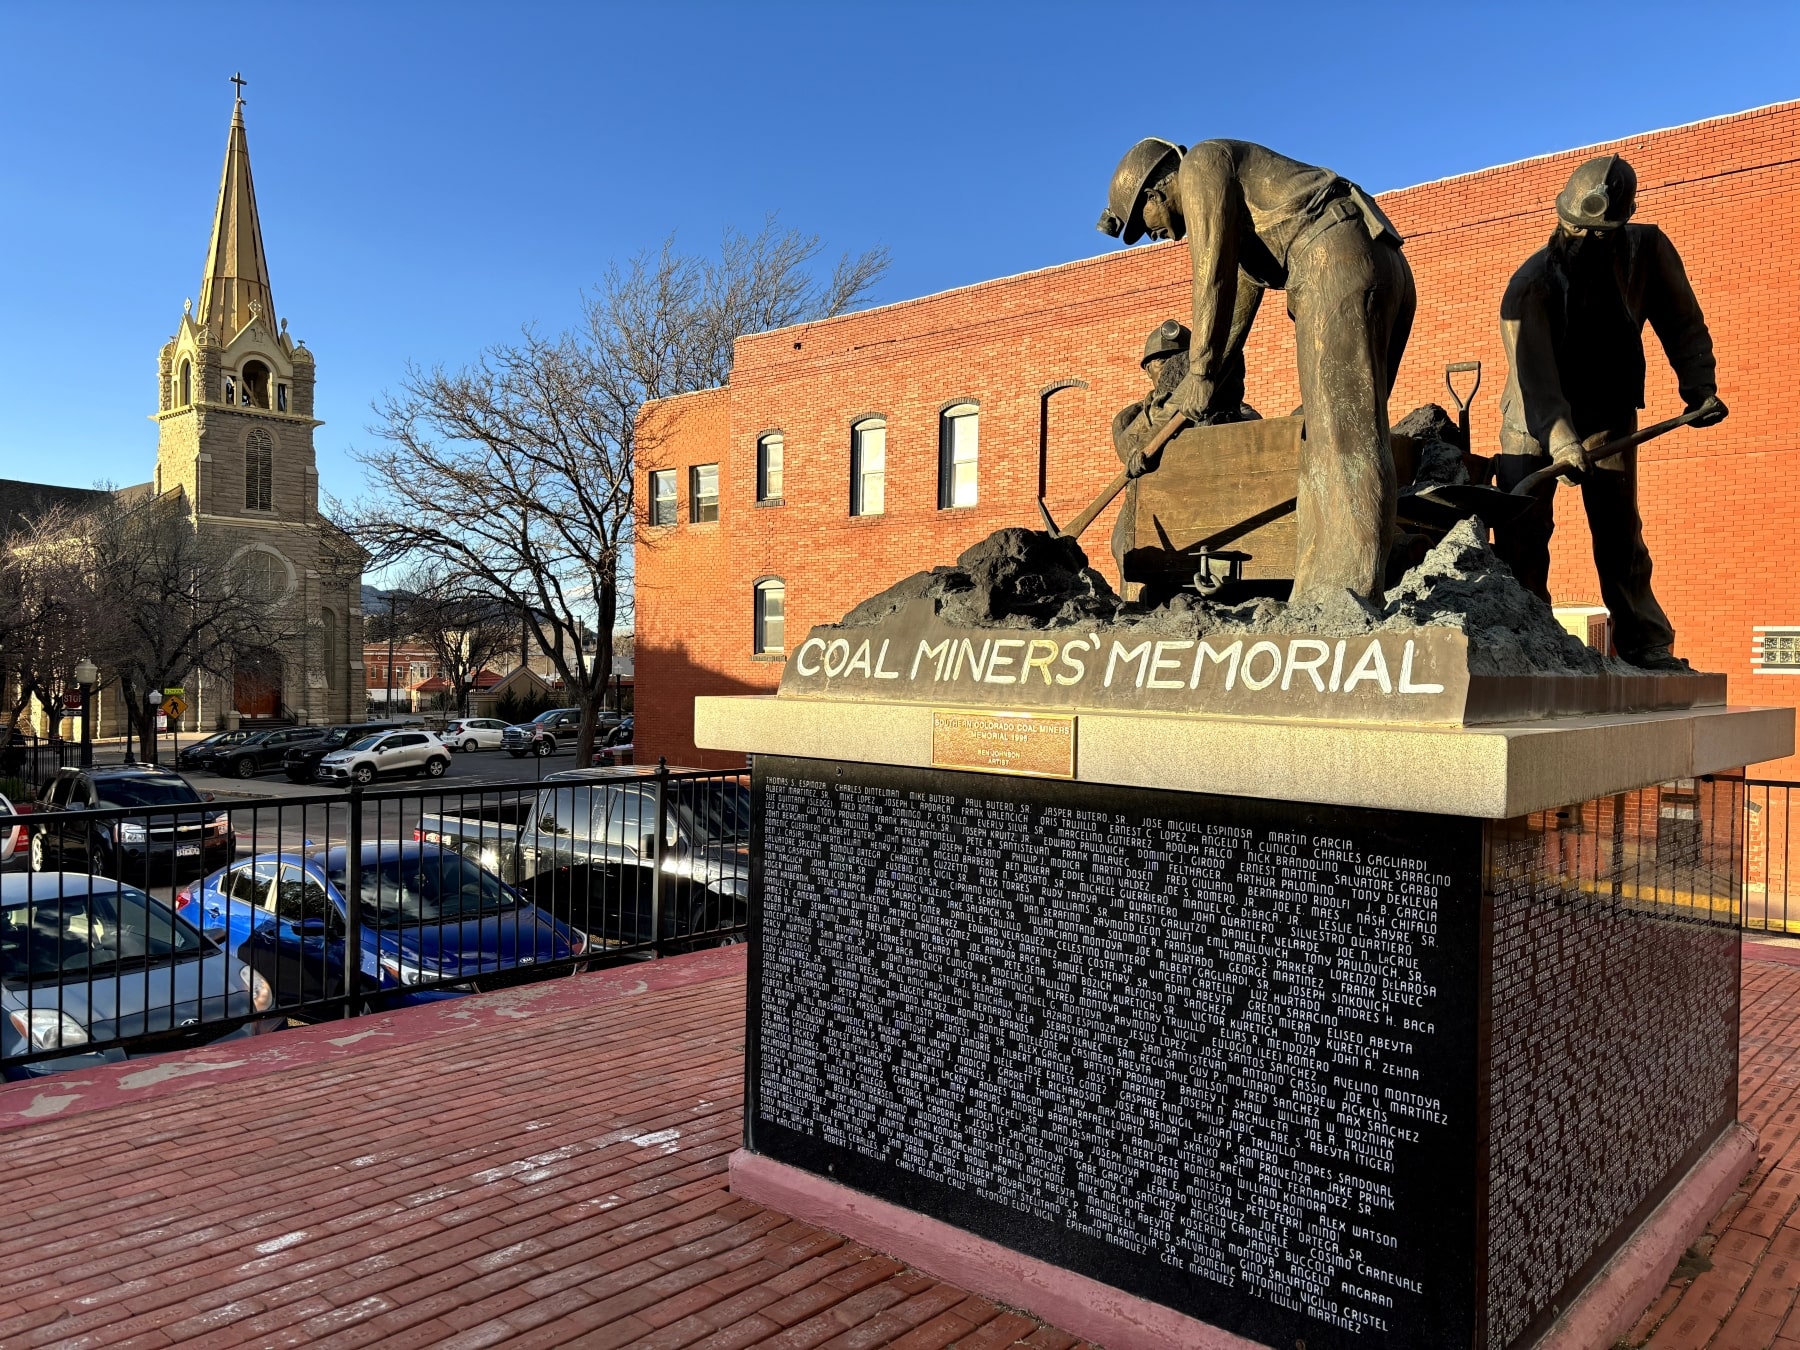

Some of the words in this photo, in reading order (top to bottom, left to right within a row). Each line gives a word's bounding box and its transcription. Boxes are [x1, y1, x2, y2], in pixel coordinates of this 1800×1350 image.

[796, 638, 900, 680] COAL
[1103, 639, 1444, 695] MEMORIAL
[935, 718, 972, 729] SOUTHERN
[974, 722, 1014, 732] COLORADO
[1017, 723, 1037, 733] COAL
[971, 731, 1008, 742] MEMORIAL
[988, 758, 1009, 766] ARTIST
[991, 751, 1021, 760] JOHNSON
[1141, 817, 1162, 829] JOSE
[1167, 820, 1202, 833] MIGUEL
[1207, 824, 1253, 839] ESPINOSA
[1268, 831, 1307, 845] MARTIN
[1312, 836, 1353, 851] GARCIA
[1005, 861, 1020, 871] BEN
[1023, 863, 1050, 876] RIVERA
[1247, 851, 1270, 864] NICK
[1275, 855, 1338, 873] BRANDOLINO
[1354, 864, 1389, 879] VIRGIL
[1394, 869, 1451, 887] SARACINO
[1313, 848, 1361, 864] CHARLES
[1367, 854, 1427, 872] GAGLIARDI
[1001, 880, 1030, 893] TORRES
[1166, 874, 1187, 886] FRED
[1191, 877, 1233, 893] GIULIANO
[1236, 873, 1276, 888] ARTHUR
[1281, 878, 1334, 896] PALOMINO
[1351, 888, 1380, 902] TONY
[1387, 892, 1438, 910] DEKLEVA
[1240, 861, 1276, 876] ERNEST
[1281, 867, 1317, 882] MATTIE
[1334, 874, 1394, 892] SALVATORE
[1400, 882, 1438, 898] GARBO
[1093, 916, 1135, 932] RAYMOND
[1139, 924, 1161, 937] LEON
[1165, 928, 1192, 943] SWIFT
[1206, 935, 1230, 949] EMIL
[1234, 940, 1288, 959] PAULOVICH
[1123, 911, 1155, 925] ERNEST
[1160, 917, 1207, 934] GARLUTZO
[1356, 912, 1385, 927] NASH
[1391, 917, 1437, 935] CHIFALO
[1290, 926, 1344, 945] SILVESTRO
[1351, 935, 1412, 956] QUARTIERO
[1228, 961, 1267, 979] GEORGE
[1272, 969, 1324, 989] MARTINEZ
[1341, 982, 1375, 998] FRANK
[1381, 989, 1423, 1008] SLEVEC
[1287, 984, 1325, 1001] JOSEPH
[1331, 992, 1389, 1013] SINKOVICH
[1132, 1008, 1162, 1024] HENRY
[1165, 1015, 1205, 1033] TRUJILLO
[1165, 982, 1191, 997] ADAM
[1196, 989, 1233, 1006] ABEYTA
[1247, 999, 1281, 1016] GRENO
[1286, 1006, 1338, 1027] SARACINO
[1250, 988, 1268, 1001] LUZ
[1273, 993, 1320, 1012] HURTADO
[1337, 1005, 1379, 1024] ANDRES
[1403, 1018, 1435, 1035] BACA
[1191, 1010, 1225, 1027] VICTOR
[1230, 1018, 1278, 1038] KURETICH
[1293, 1031, 1321, 1047] TONY
[1326, 1038, 1379, 1060] KURETICH
[1241, 1009, 1273, 1026] JAMES
[1278, 1016, 1311, 1033] MIERA
[1327, 1026, 1363, 1044] ELISEO
[1369, 1035, 1413, 1055] ABEYTA
[1083, 1059, 1122, 1078] BATTISTA
[1126, 1070, 1166, 1090] PADOVAN
[1257, 1046, 1282, 1062] (LEE)
[1287, 1053, 1329, 1073] ROMERO
[1048, 1080, 1101, 1104] RICHARDSON
[1242, 1066, 1284, 1086] ANTONIO
[1290, 1077, 1327, 1096] CASSIO
[1333, 1075, 1378, 1096] AVELINO
[1384, 1087, 1440, 1111] MONTOYA
[1243, 1089, 1267, 1104] FRED
[1272, 1096, 1319, 1118] SANCHEZ
[1336, 1112, 1361, 1128] MAX
[1367, 1119, 1419, 1143] SANCHEZ
[1292, 1089, 1335, 1110] ANDREW
[1341, 1101, 1388, 1123] PICKENS
[1270, 1130, 1289, 1145] ABE
[1310, 1140, 1350, 1162] ABEYTA
[1355, 1153, 1394, 1174] (TIGER)
[1304, 1127, 1322, 1142] JOE
[1345, 1138, 1393, 1161] TRUJILLO
[1177, 1148, 1214, 1169] VITERVO
[1219, 1161, 1243, 1177] RAEL
[1293, 1159, 1332, 1180] ANDRES
[1338, 1172, 1393, 1198] SANDOVAL
[1075, 1160, 1097, 1176] GABE
[1101, 1168, 1133, 1187] GARCIA
[1147, 1182, 1186, 1204] LEANDRO
[1191, 1197, 1245, 1224] VELASQUEZ
[1233, 1154, 1254, 1169] SAM
[1259, 1161, 1311, 1186] PROVENZA
[1327, 1181, 1352, 1198] JAKE
[1359, 1190, 1395, 1211] PRUNK
[1237, 1177, 1277, 1199] WILLIAM
[1283, 1191, 1327, 1214] KOMORA
[1319, 1214, 1346, 1233] ALEX
[1352, 1224, 1397, 1249] WATSON
[1160, 1251, 1183, 1269] GENE
[1189, 1262, 1234, 1288] MARQUEZ
[1290, 1263, 1330, 1287] ANGELO
[1341, 1281, 1393, 1309] ANGARAN
[1310, 1247, 1352, 1271] COSIMO
[1357, 1262, 1423, 1294] CARNEVALE
[1300, 1290, 1338, 1314] VIGILIO
[1343, 1306, 1386, 1331] CRISTEL
